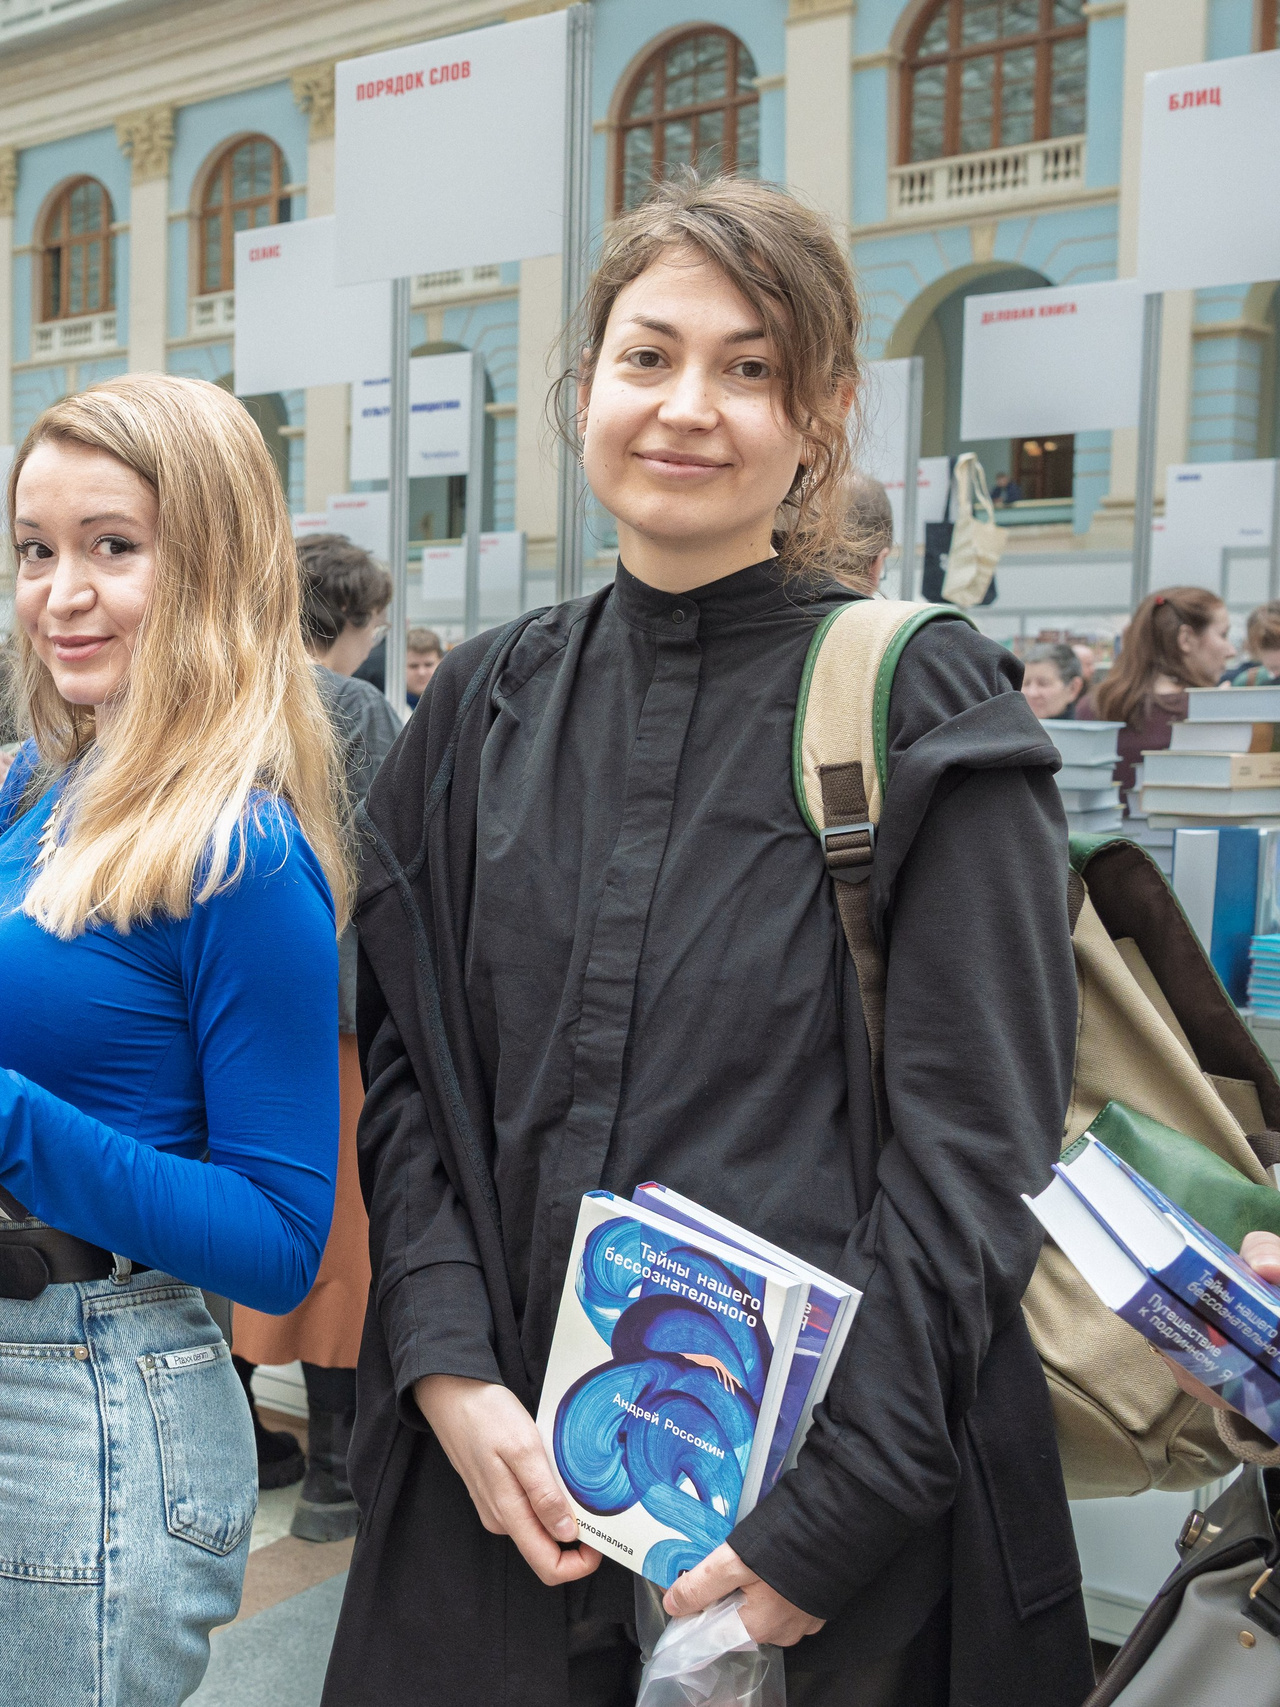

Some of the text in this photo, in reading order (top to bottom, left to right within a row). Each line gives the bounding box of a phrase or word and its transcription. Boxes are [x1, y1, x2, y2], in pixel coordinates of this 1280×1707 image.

[356, 60, 471, 101] ПОРЯДОК СЛОВ
[1168, 86, 1221, 112] БЛИЦ
[249, 244, 281, 262] СЕАНС
[982, 302, 1077, 325] ДЕЛОВАЯ КНИГА
[604, 1246, 758, 1328] бессознательного
[640, 1242, 761, 1311] Тайны нашего
[1198, 1269, 1278, 1339] Тайны нашего
[1147, 1293, 1222, 1358] Путешествие
[1148, 1315, 1219, 1372] подлинному
[1218, 1369, 1234, 1381] Я
[612, 1392, 726, 1459] Андрей Россохин
[575, 1518, 634, 1556] сихоанализа
